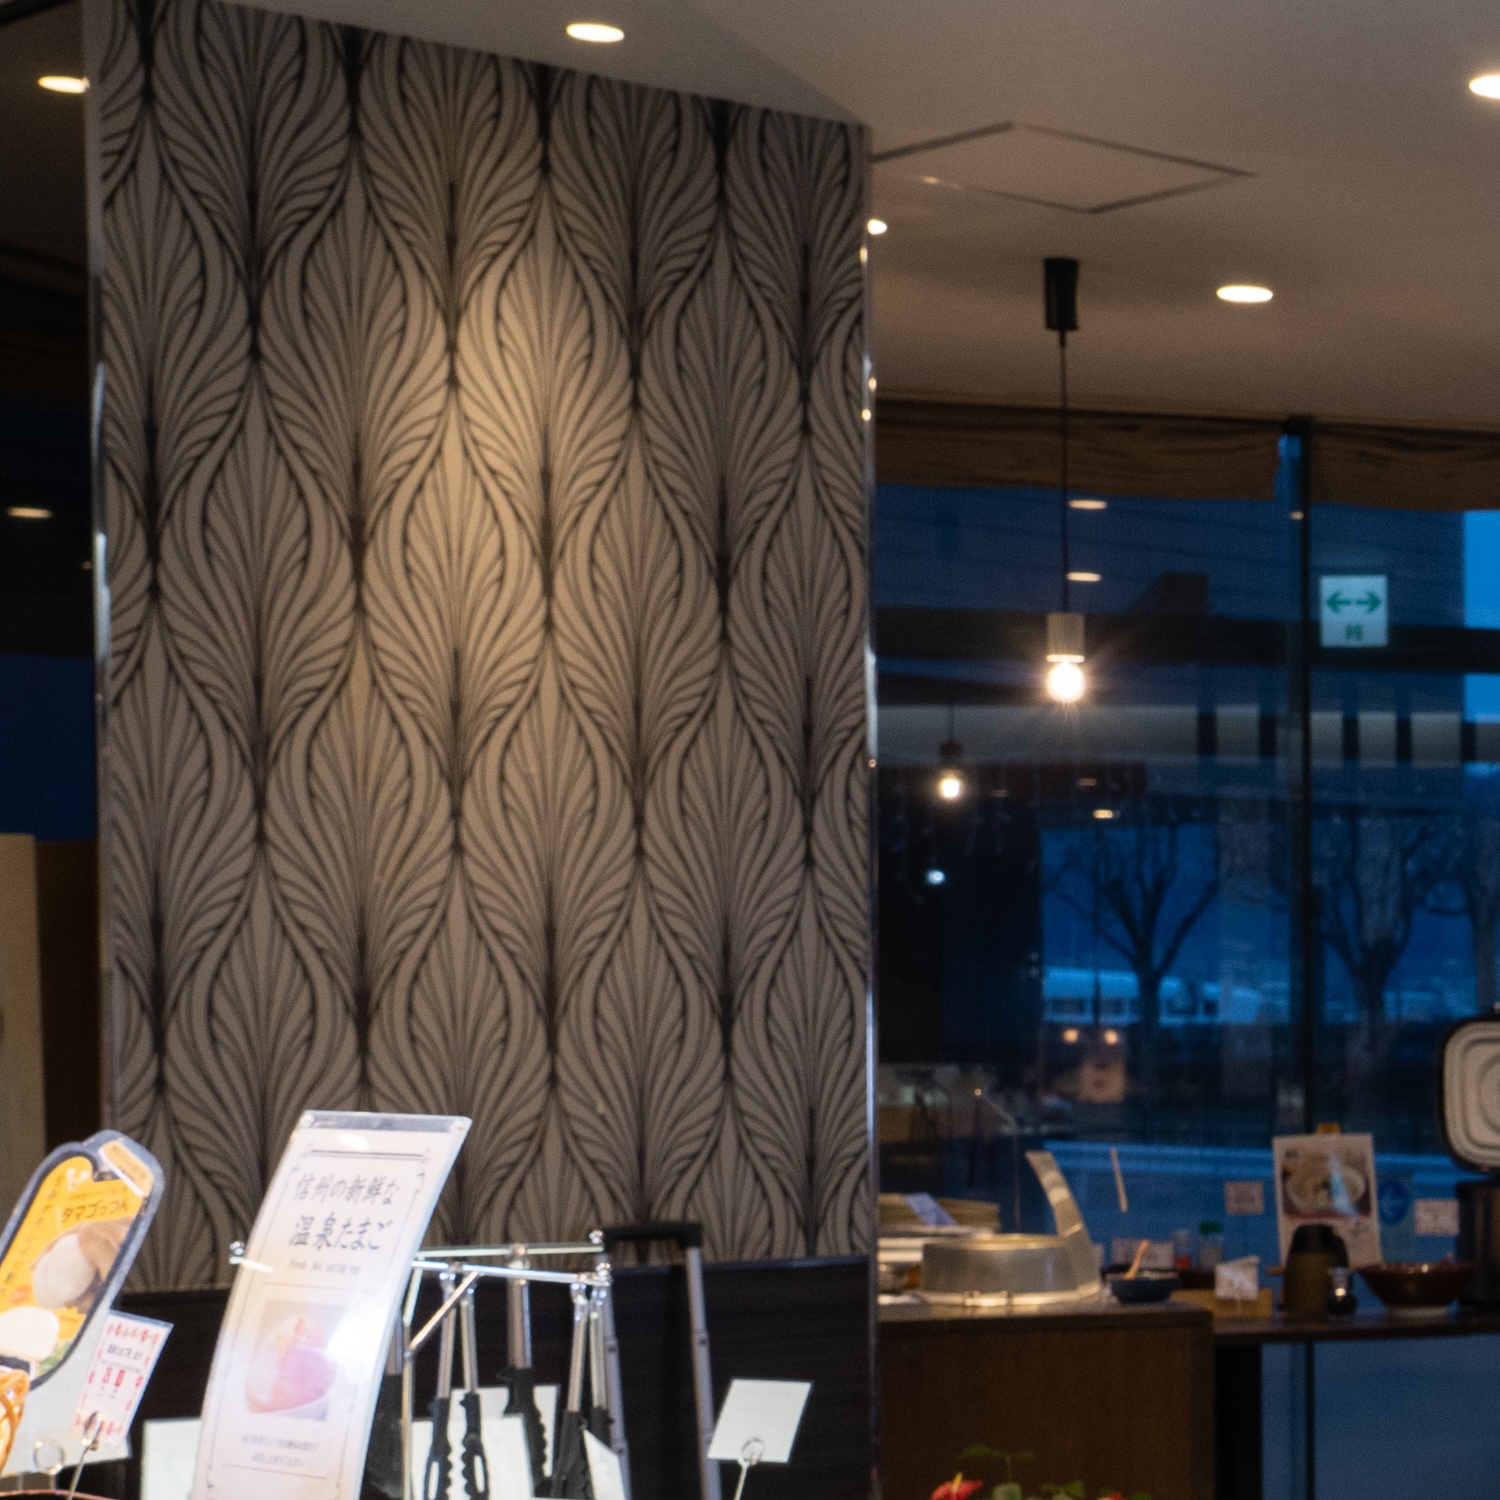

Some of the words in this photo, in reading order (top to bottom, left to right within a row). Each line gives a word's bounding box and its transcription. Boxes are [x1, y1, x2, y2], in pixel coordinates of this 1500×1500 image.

[294, 1172, 400, 1205] 信州の新鮮な
[288, 1211, 394, 1251] 温泉たまご
